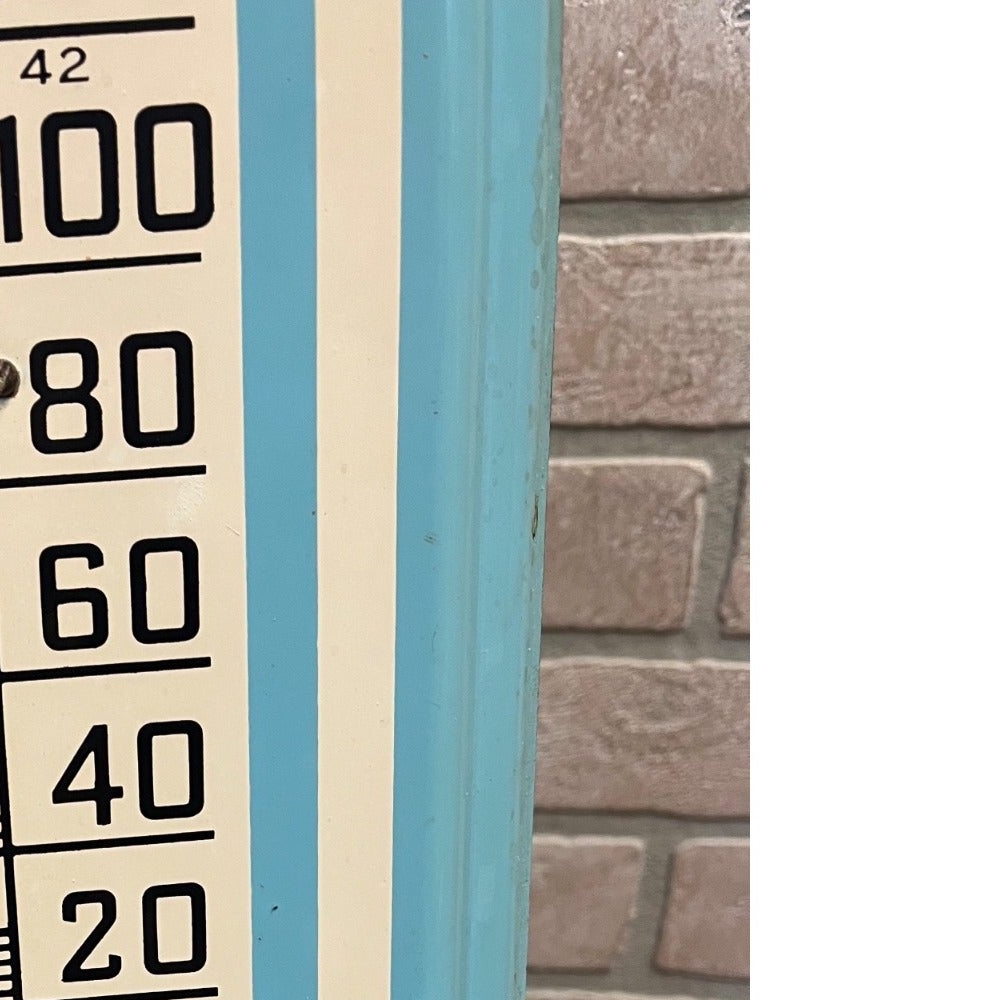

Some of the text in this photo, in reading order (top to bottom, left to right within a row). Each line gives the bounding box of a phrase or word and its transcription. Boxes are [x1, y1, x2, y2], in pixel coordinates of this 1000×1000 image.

[20, 46, 90, 85] 42
[29, 330, 195, 455] 80
[38, 535, 200, 652] 60
[51, 719, 205, 826] 40
[61, 882, 207, 983] 20
